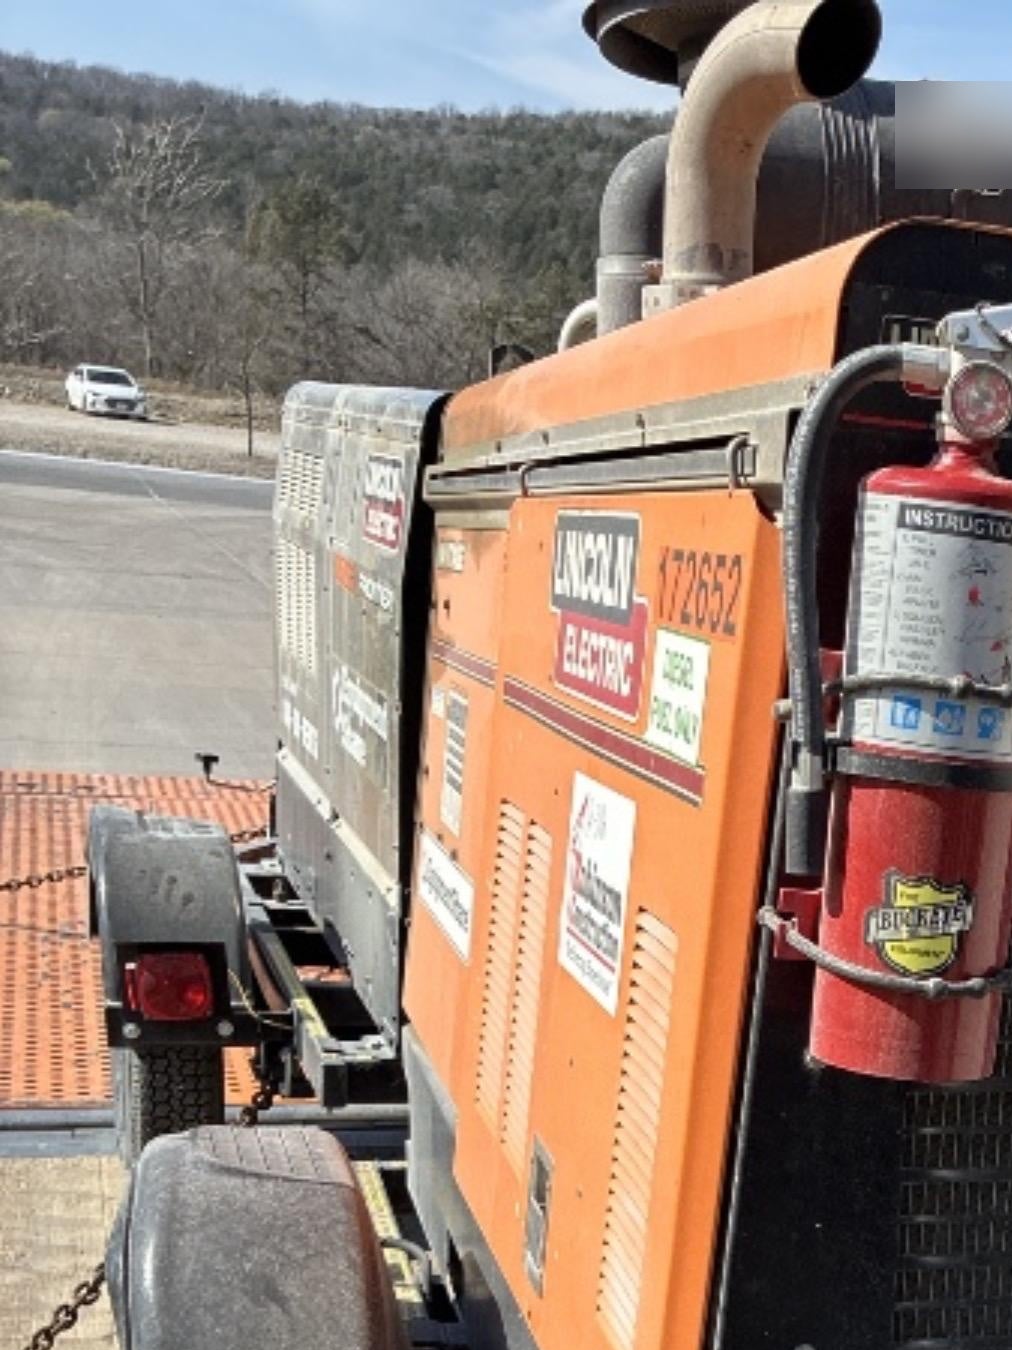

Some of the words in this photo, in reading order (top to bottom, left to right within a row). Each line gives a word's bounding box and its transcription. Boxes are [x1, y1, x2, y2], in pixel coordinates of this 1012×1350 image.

[553, 529, 635, 610] LINCOLN
[657, 546, 743, 637] 172652
[562, 623, 634, 697] ELECTRIC
